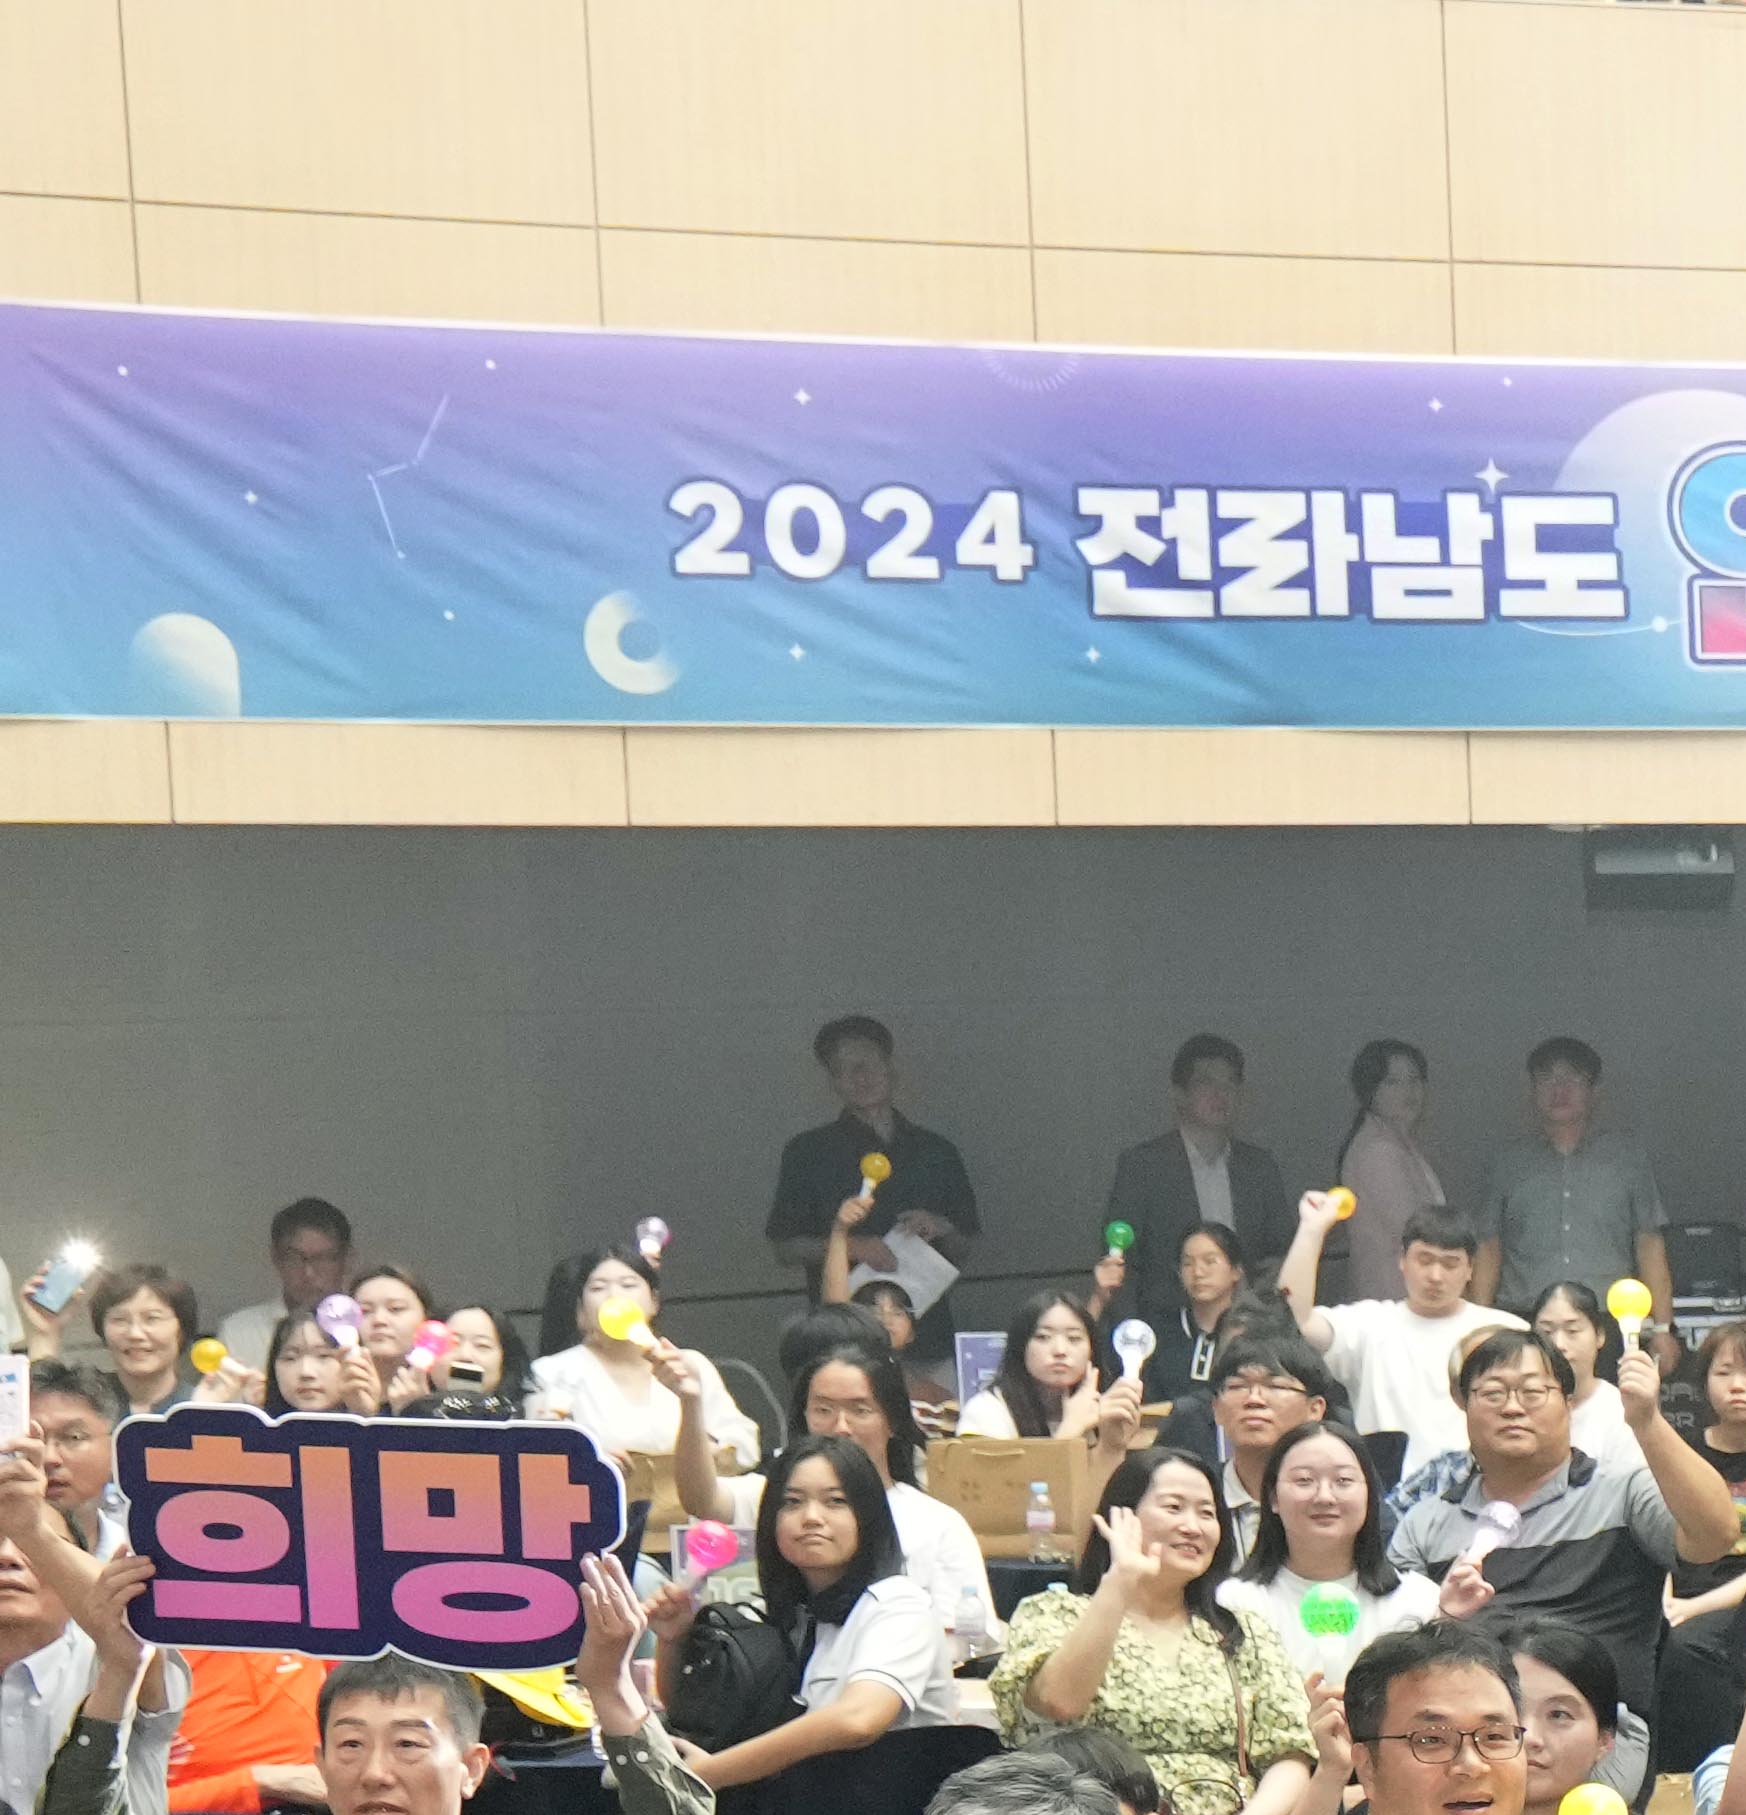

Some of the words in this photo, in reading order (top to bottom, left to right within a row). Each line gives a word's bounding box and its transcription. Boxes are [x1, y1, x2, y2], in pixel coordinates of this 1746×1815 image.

[668, 479, 1036, 583] 2024
[1073, 486, 1630, 624] 전라남도
[145, 1434, 591, 1643] 희망
